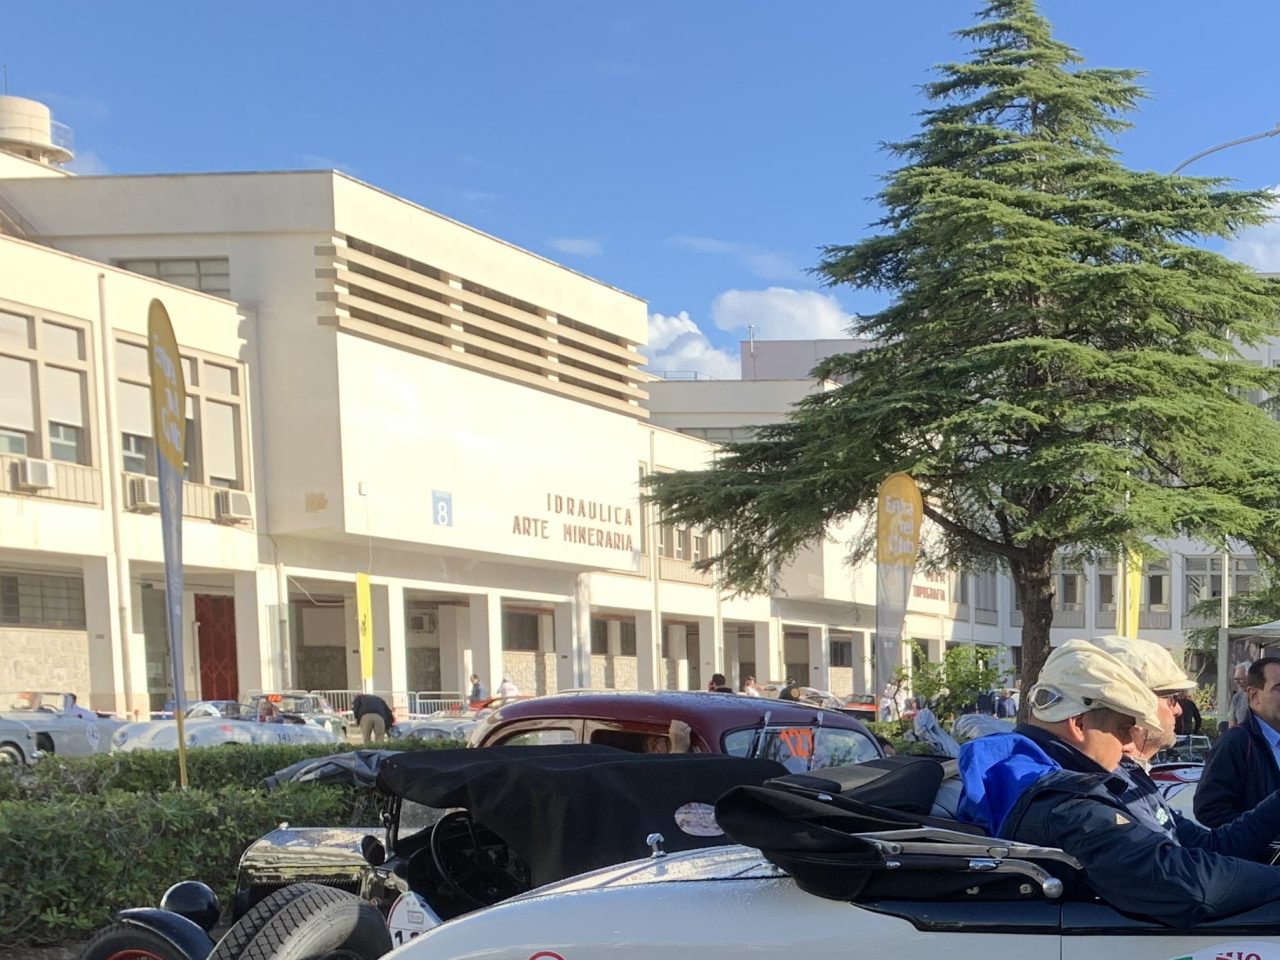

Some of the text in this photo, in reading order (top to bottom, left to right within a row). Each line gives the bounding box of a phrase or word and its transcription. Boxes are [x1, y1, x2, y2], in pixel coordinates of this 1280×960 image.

[438, 501, 448, 526] 8
[547, 492, 633, 527] IDRAULICA
[512, 515, 634, 553] ARTE MINERARIA
